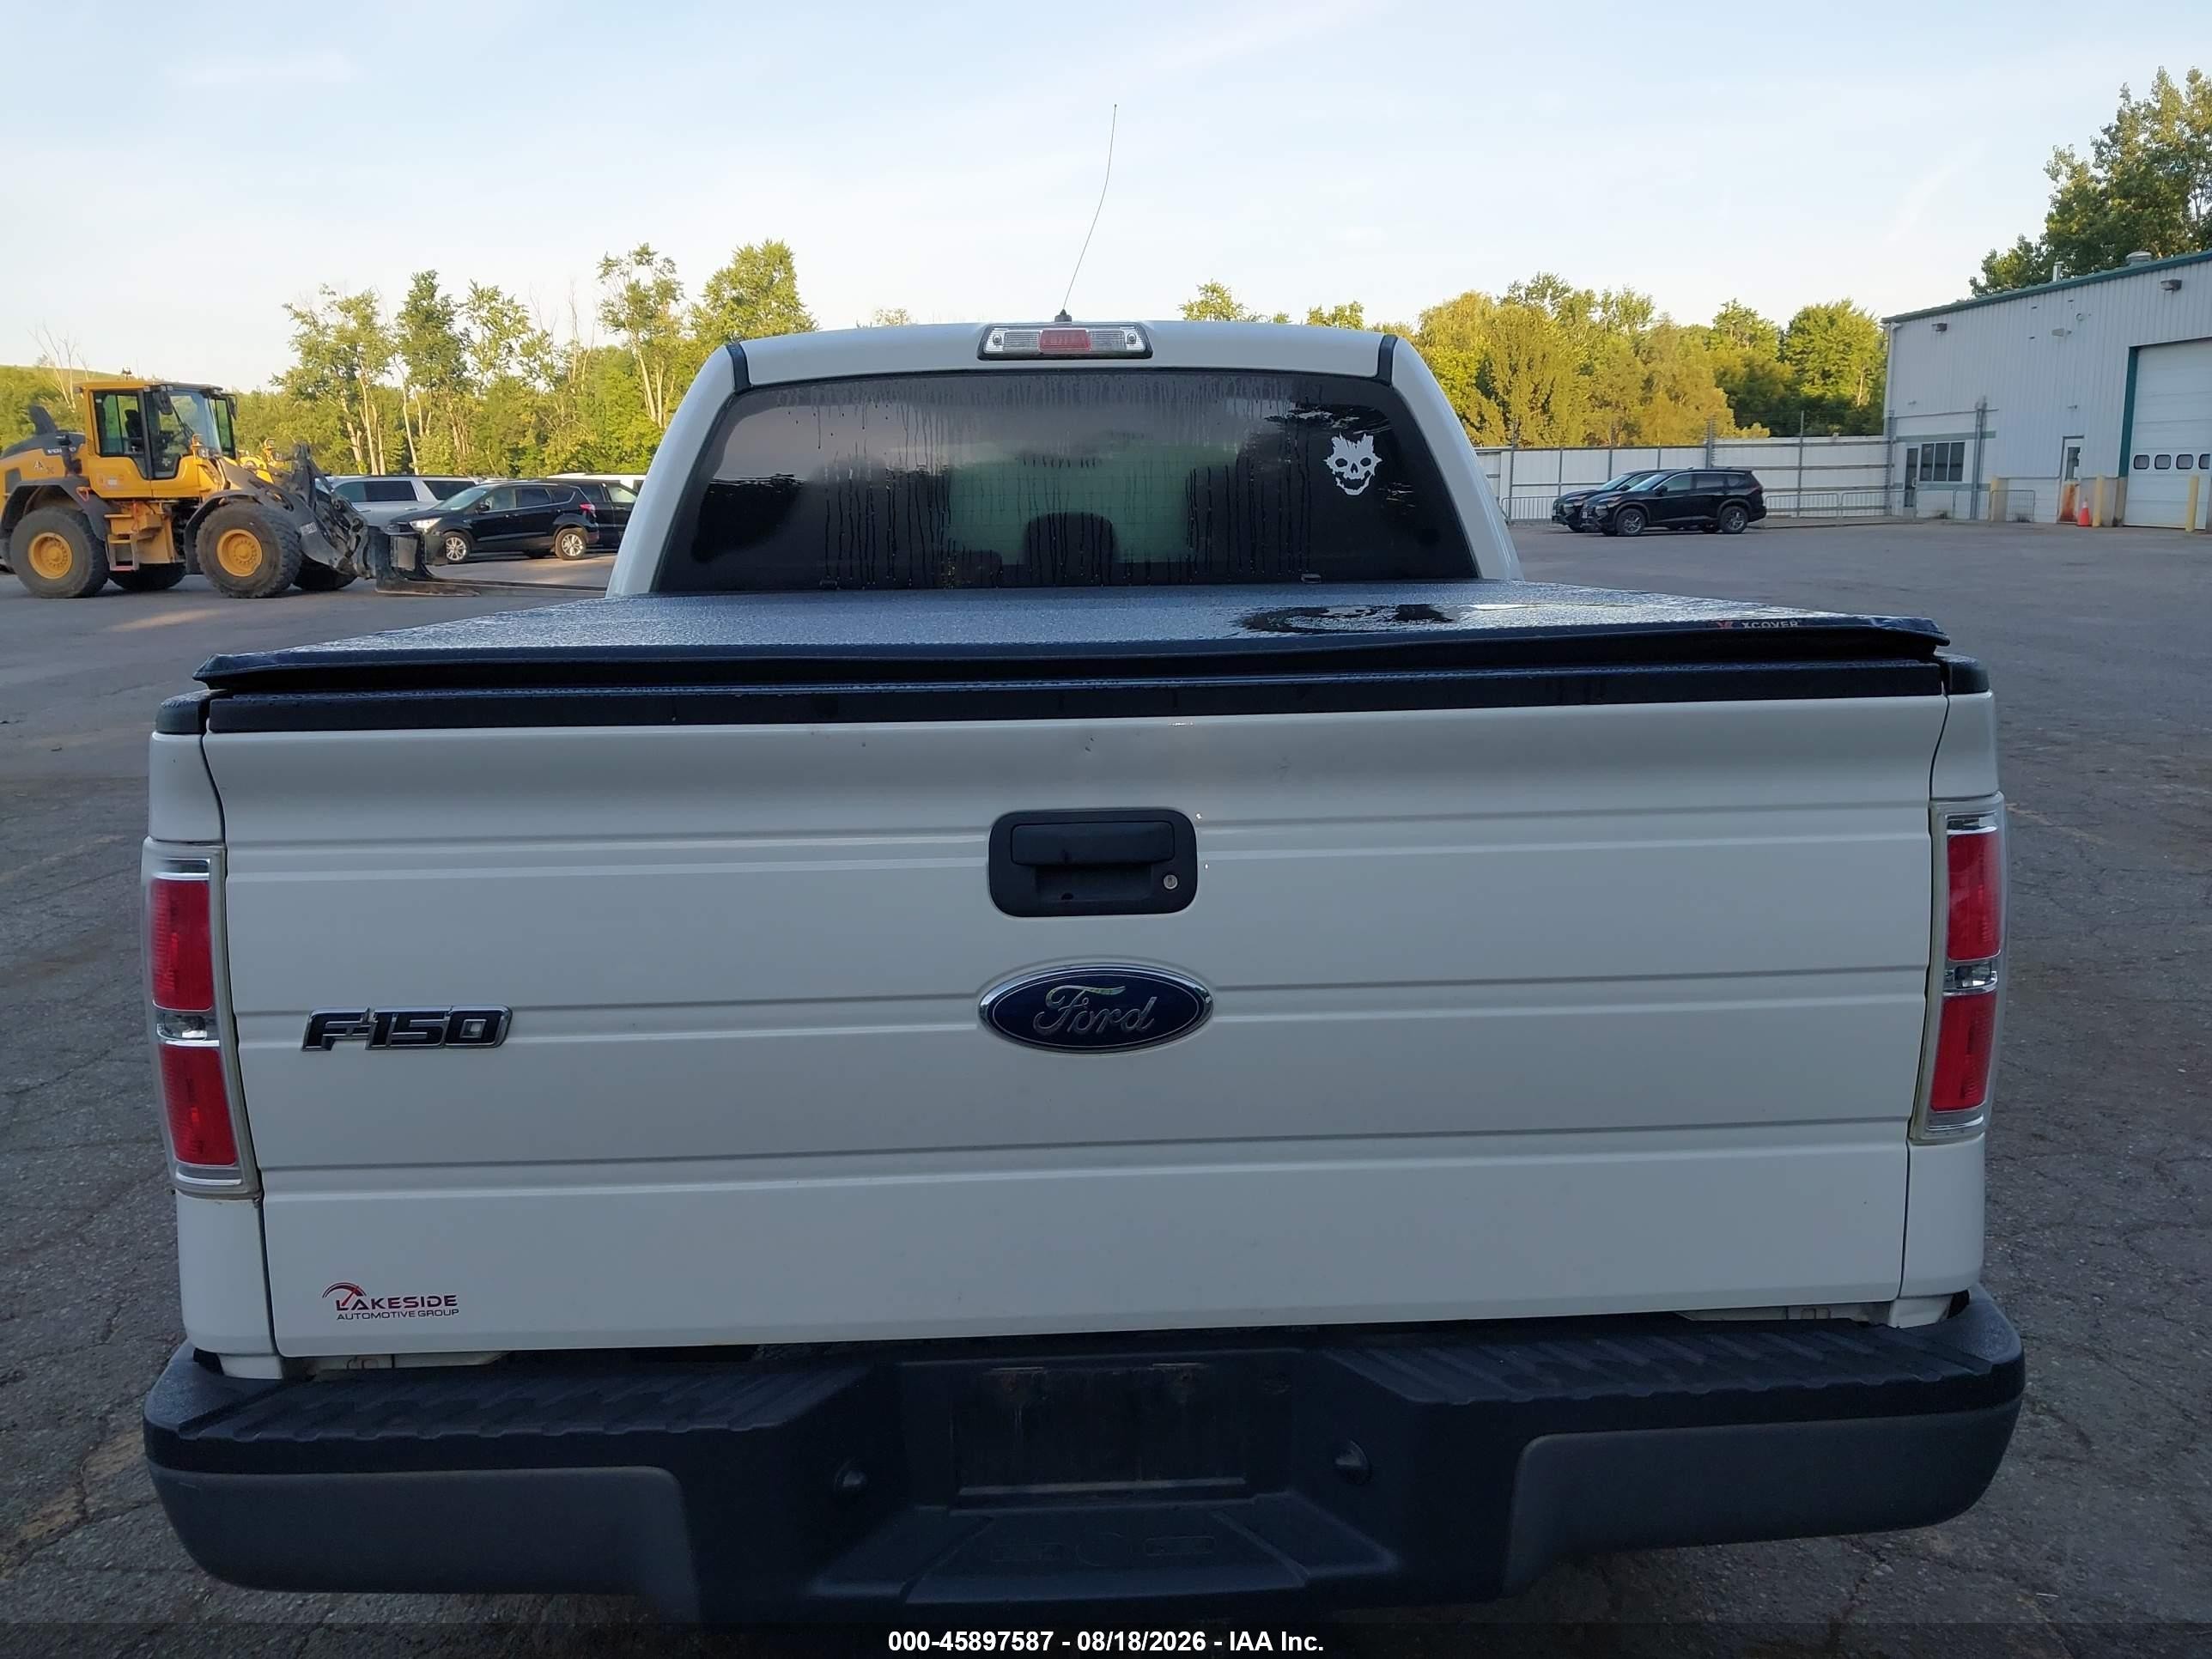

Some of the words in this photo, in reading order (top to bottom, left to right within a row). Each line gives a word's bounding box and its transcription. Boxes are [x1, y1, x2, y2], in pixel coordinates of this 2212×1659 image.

[1033, 984, 1157, 1035] Ford
[301, 1005, 514, 1051] F-150
[336, 1294, 459, 1311] LAKESIDE
[337, 1310, 416, 1321] AUTOMOTIVE
[417, 1309, 459, 1318] GROUP
